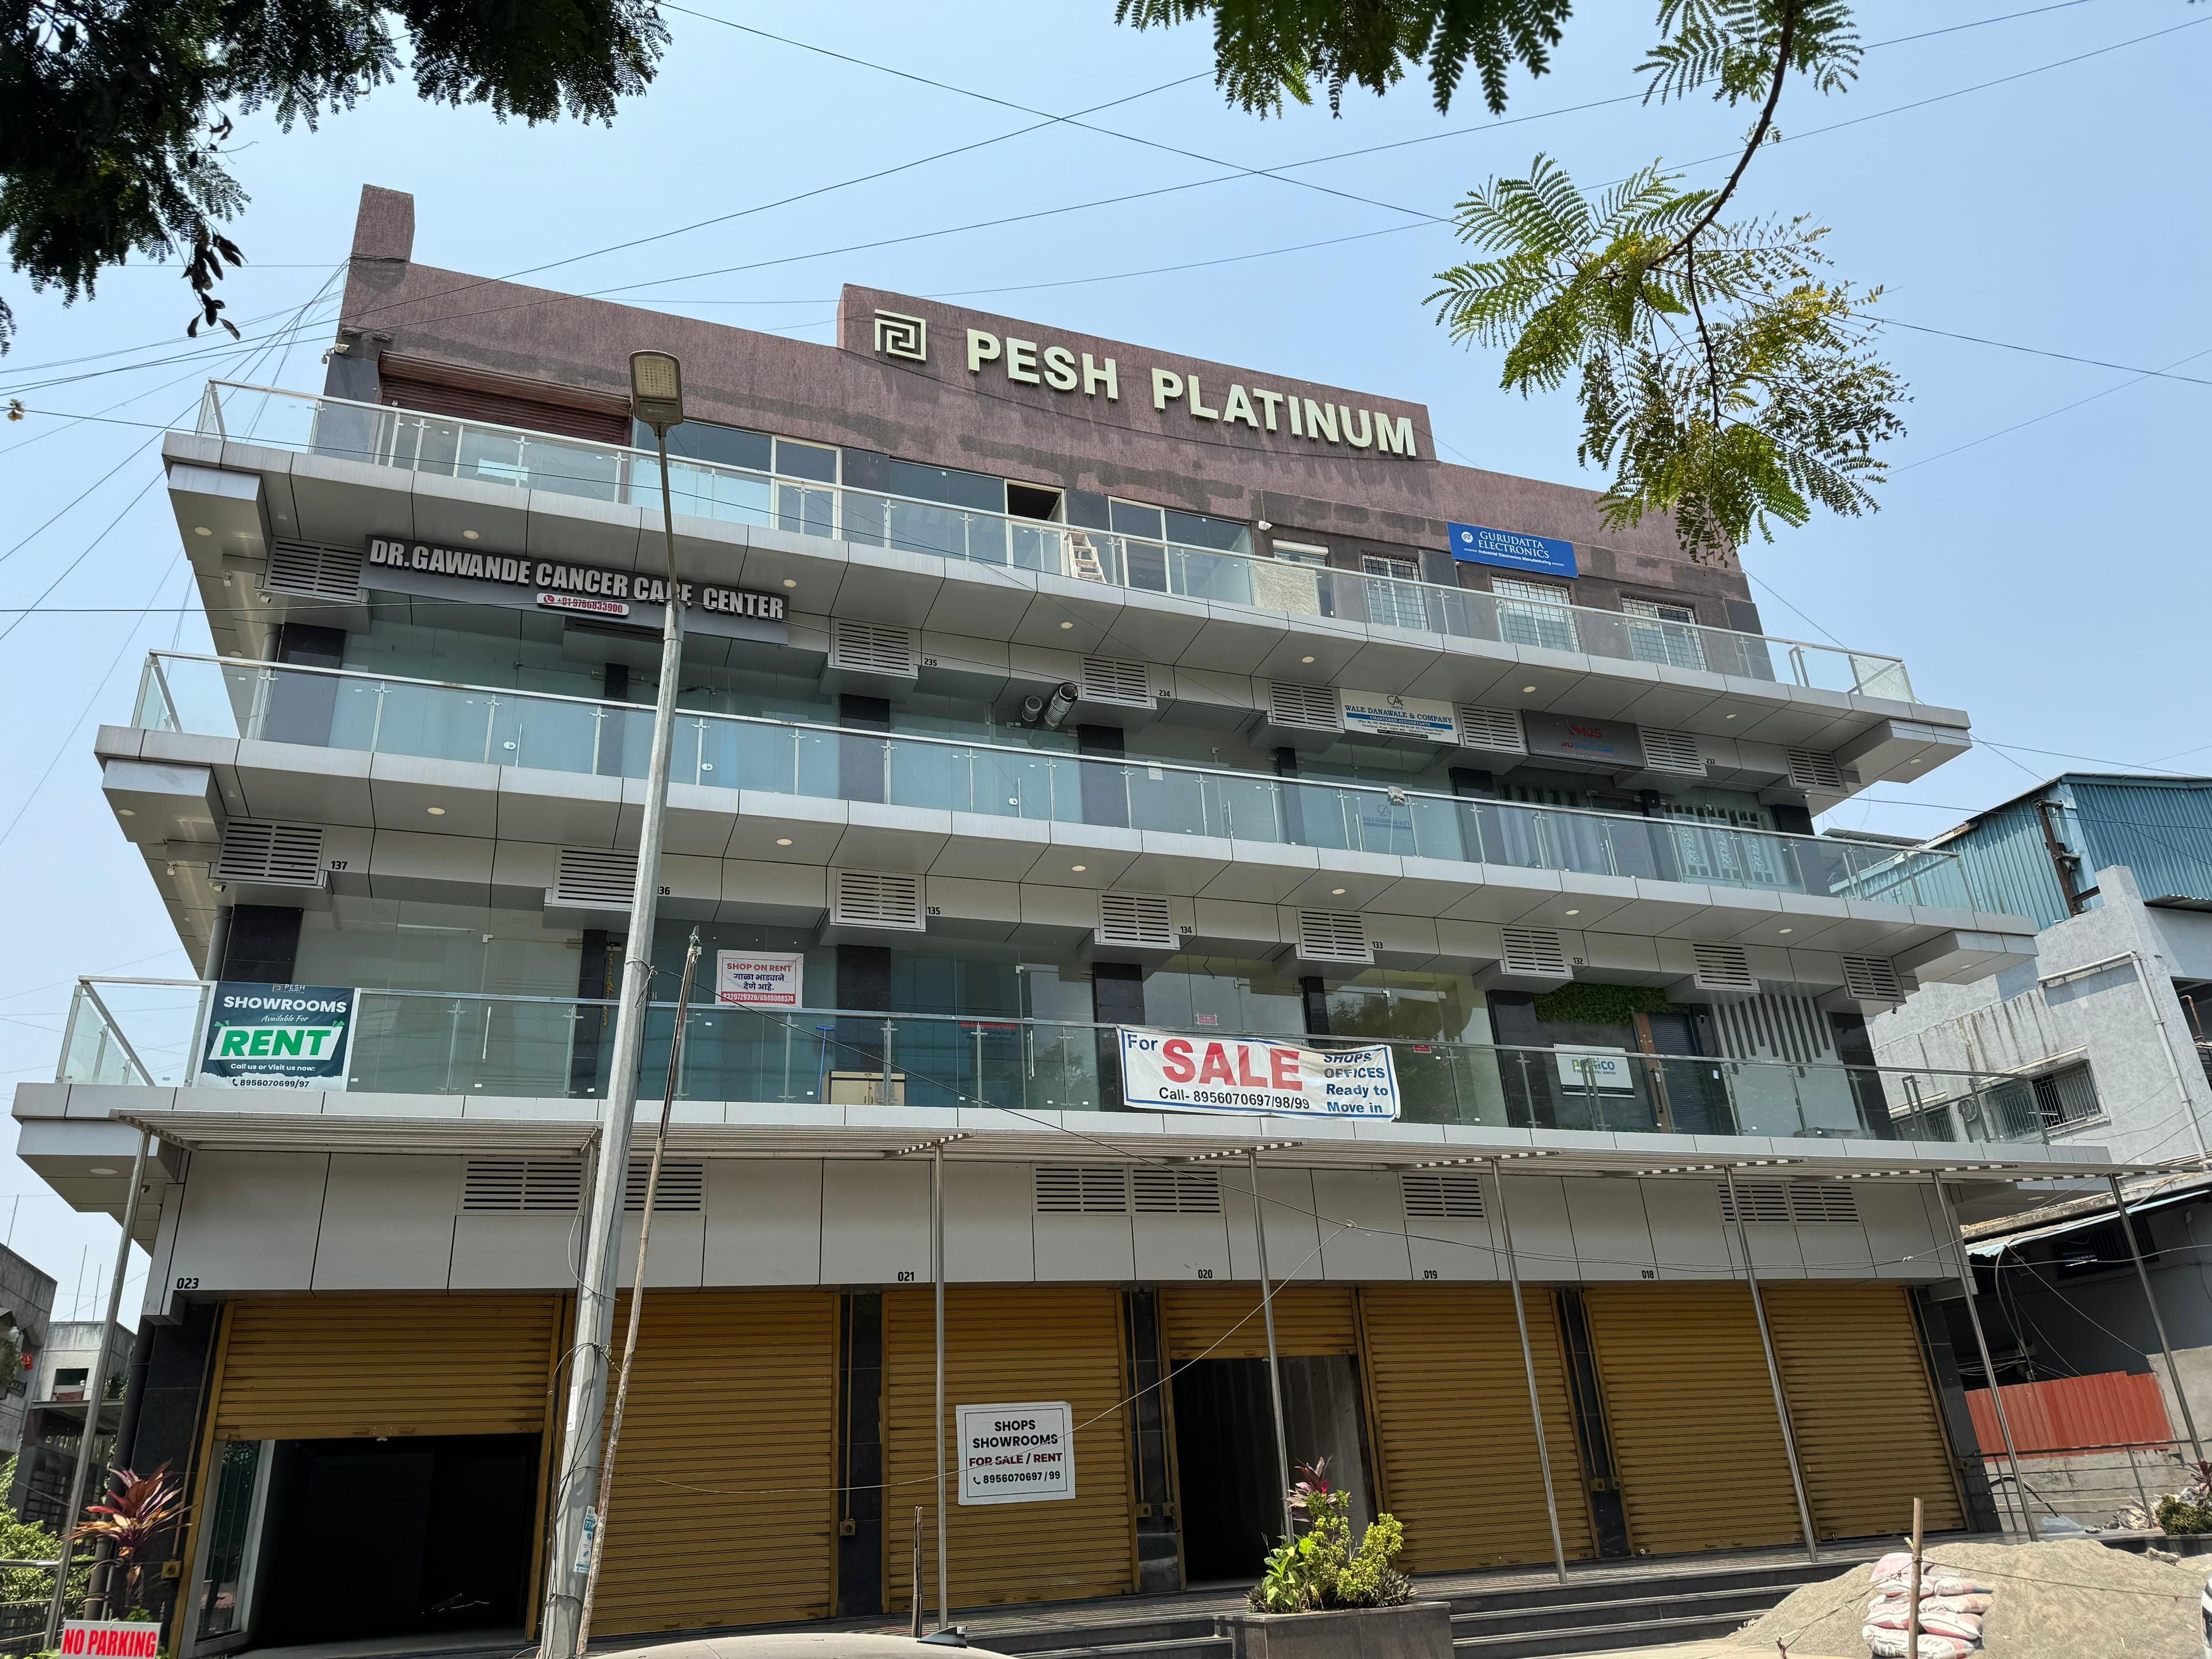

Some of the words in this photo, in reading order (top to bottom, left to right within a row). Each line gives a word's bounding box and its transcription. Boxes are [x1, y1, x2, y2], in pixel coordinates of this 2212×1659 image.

[967, 328, 1119, 402] PESH
[1152, 367, 1416, 457] PLATINUM
[1479, 531, 1544, 549] GURUDATTA
[1478, 539, 1550, 559] ELECTRONICS
[1498, 552, 1521, 560] Electronics
[1522, 556, 1552, 566] Manufacturing
[536, 563, 628, 599] CANCER
[634, 577, 692, 607] CARE
[702, 588, 783, 619] CENTER
[924, 658, 937, 666] 235
[1159, 689, 1170, 698] 234
[1344, 704, 1366, 713] WALE
[1368, 708, 1407, 718] DANAWALE
[1417, 714, 1452, 724] COMPANY
[1370, 715, 1398, 724] CHARTERED
[1398, 719, 1431, 727] ACCOUNTANTS
[331, 860, 348, 870] 137
[927, 906, 941, 915] 135
[1180, 926, 1192, 934] 134
[1372, 941, 1384, 949] 133
[1573, 957, 1584, 965] 132
[727, 963, 752, 971] SHOP
[753, 964, 768, 972] ON
[769, 964, 792, 972] RENT
[743, 981, 756, 990] देणे
[224, 995, 347, 1013] SHOWROOMS
[261, 1014, 294, 1022] Available
[296, 1014, 309, 1022] For
[220, 1029, 332, 1056] RENT
[1127, 1033, 1158, 1051] For
[1162, 1039, 1303, 1091] SALE
[1323, 1052, 1373, 1063] SHOPS
[1324, 1067, 1386, 1078] OFFICES
[240, 1079, 309, 1088] 8956070699/97
[1326, 1084, 1369, 1098] Ready
[1373, 1085, 1388, 1096] to
[1193, 1090, 1310, 1109] 8956070697/98/99
[1327, 1101, 1365, 1112] Move
[1369, 1102, 1382, 1113] in
[897, 1272, 915, 1282] 021
[1198, 1269, 1213, 1279] 020
[1424, 1270, 1438, 1279] 019
[1641, 1270, 1654, 1279] 018
[176, 1278, 199, 1290] 023
[994, 1419, 1036, 1432] SHOPS
[972, 1433, 1058, 1449] SHOWROOMS
[969, 1456, 993, 1467] FOR
[995, 1455, 1024, 1465] SALE
[1033, 1453, 1063, 1463] RENT
[62, 1628, 85, 1656] NO
[86, 1629, 157, 1658] PARKING
